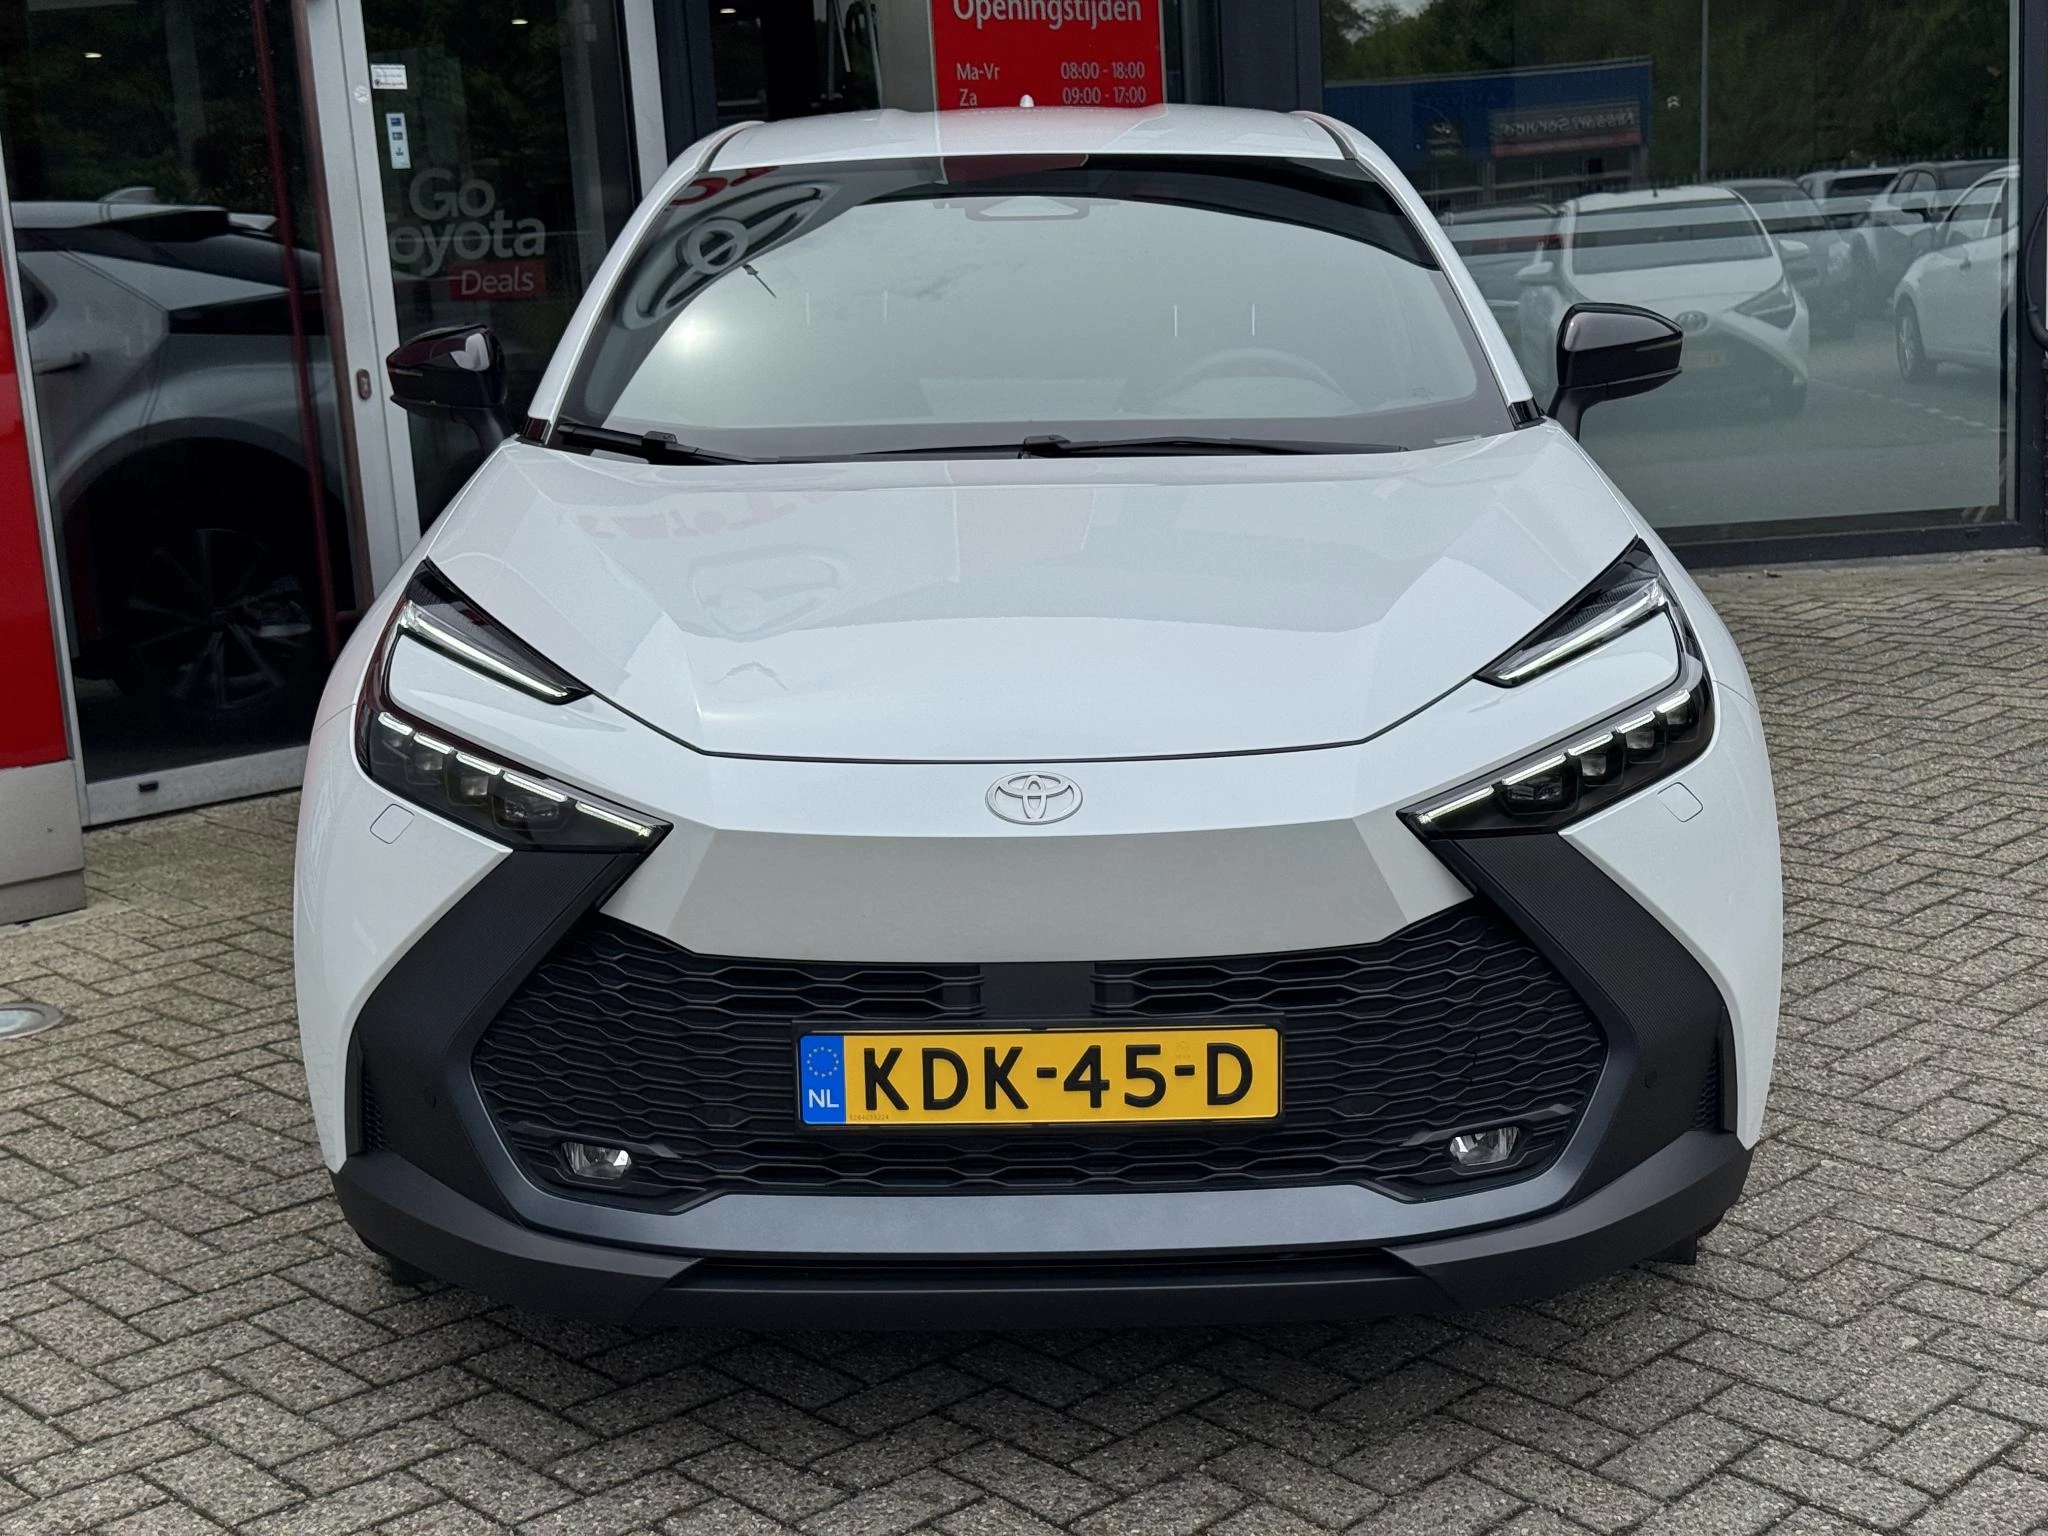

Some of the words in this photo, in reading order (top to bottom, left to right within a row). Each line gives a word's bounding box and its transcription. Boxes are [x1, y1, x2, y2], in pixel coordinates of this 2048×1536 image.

[953, 0, 1142, 29] Openingstijden
[956, 63, 1000, 80] Ma-Vr
[1060, 62, 1099, 80] 08:00
[1112, 62, 1145, 79] 18:00
[959, 88, 978, 107] Za
[1062, 87, 1101, 105] 09:00
[1114, 87, 1147, 104] 17:00
[409, 168, 496, 221] Go
[385, 210, 546, 277] oyota
[461, 266, 535, 295] Deals
[863, 1042, 1254, 1111] KDK-45-D
[808, 1088, 840, 1109] NL
